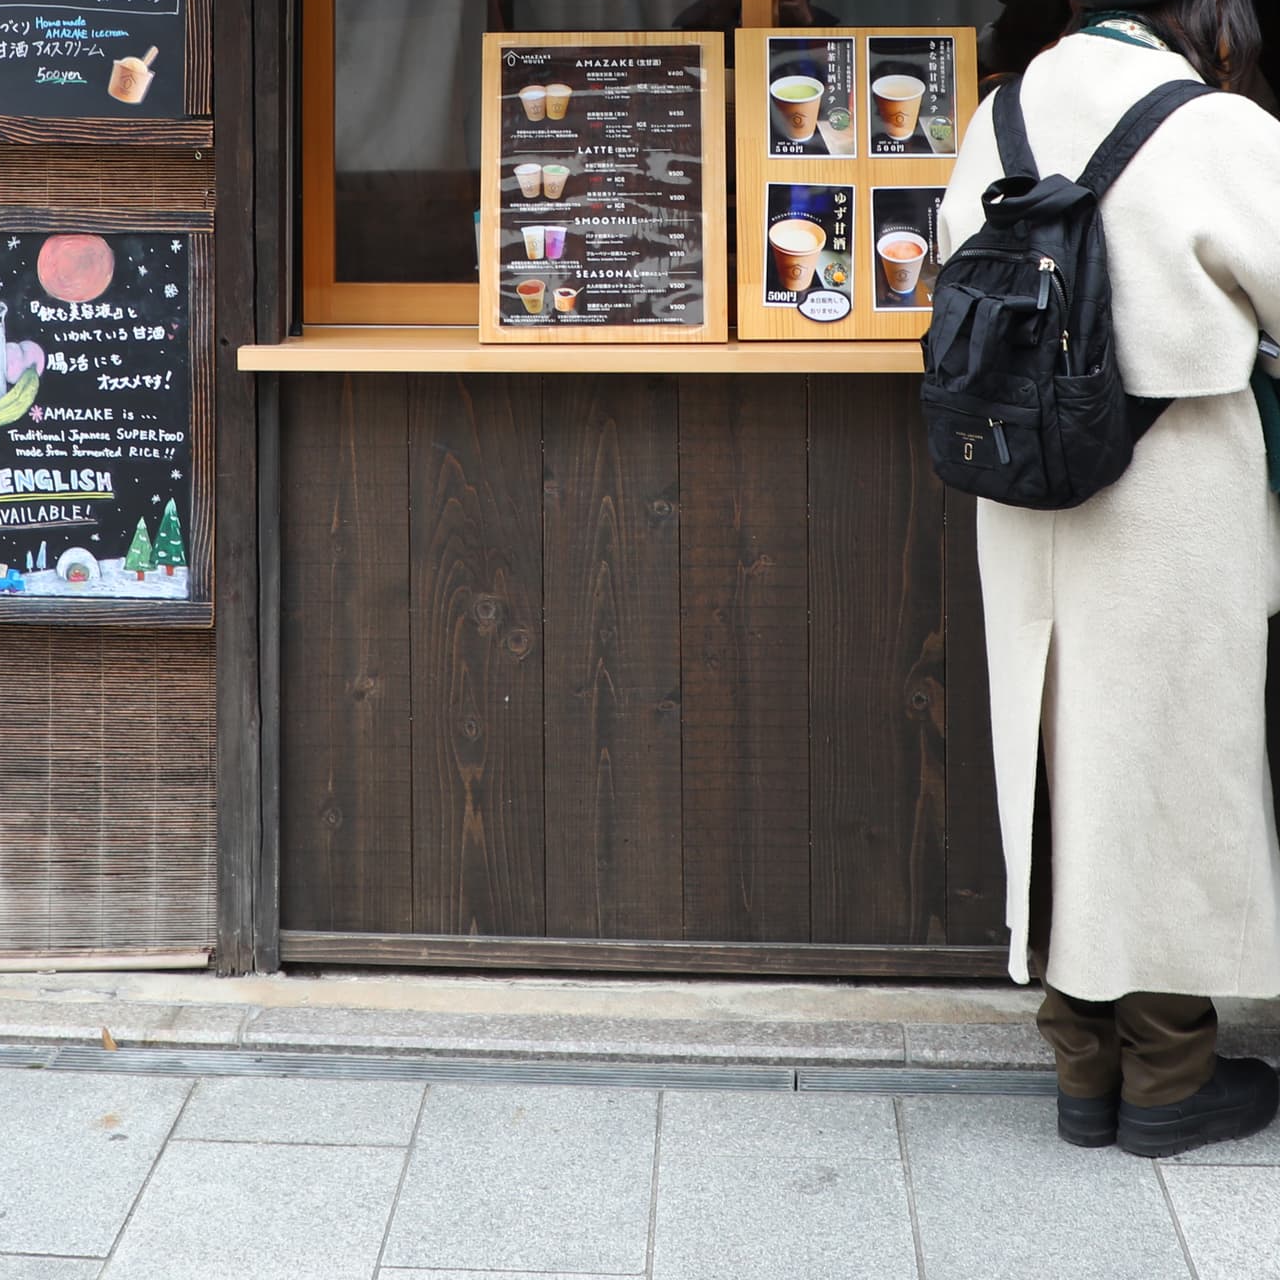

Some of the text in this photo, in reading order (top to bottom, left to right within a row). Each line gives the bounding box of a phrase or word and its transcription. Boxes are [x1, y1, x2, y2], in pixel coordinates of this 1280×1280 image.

[45, 27, 89, 39] AMAZAKE
[575, 59, 635, 68] AMAZAKE
[37, 67, 83, 84] 500yen
[577, 145, 613, 155] LATTE
[775, 144, 804, 153] 500円
[876, 144, 905, 153] 500円
[574, 216, 638, 225] SMOOTHIE
[833, 192, 847, 251] ゆず甘酒
[575, 270, 639, 279] SEASONAL
[767, 291, 798, 303] 500円
[43, 408, 135, 420] AMAZAKE is
[8, 429, 65, 442] Traditional
[68, 430, 111, 444] Japanese
[16, 447, 43, 458] made
[45, 445, 68, 457] from
[72, 446, 122, 458] fermented
